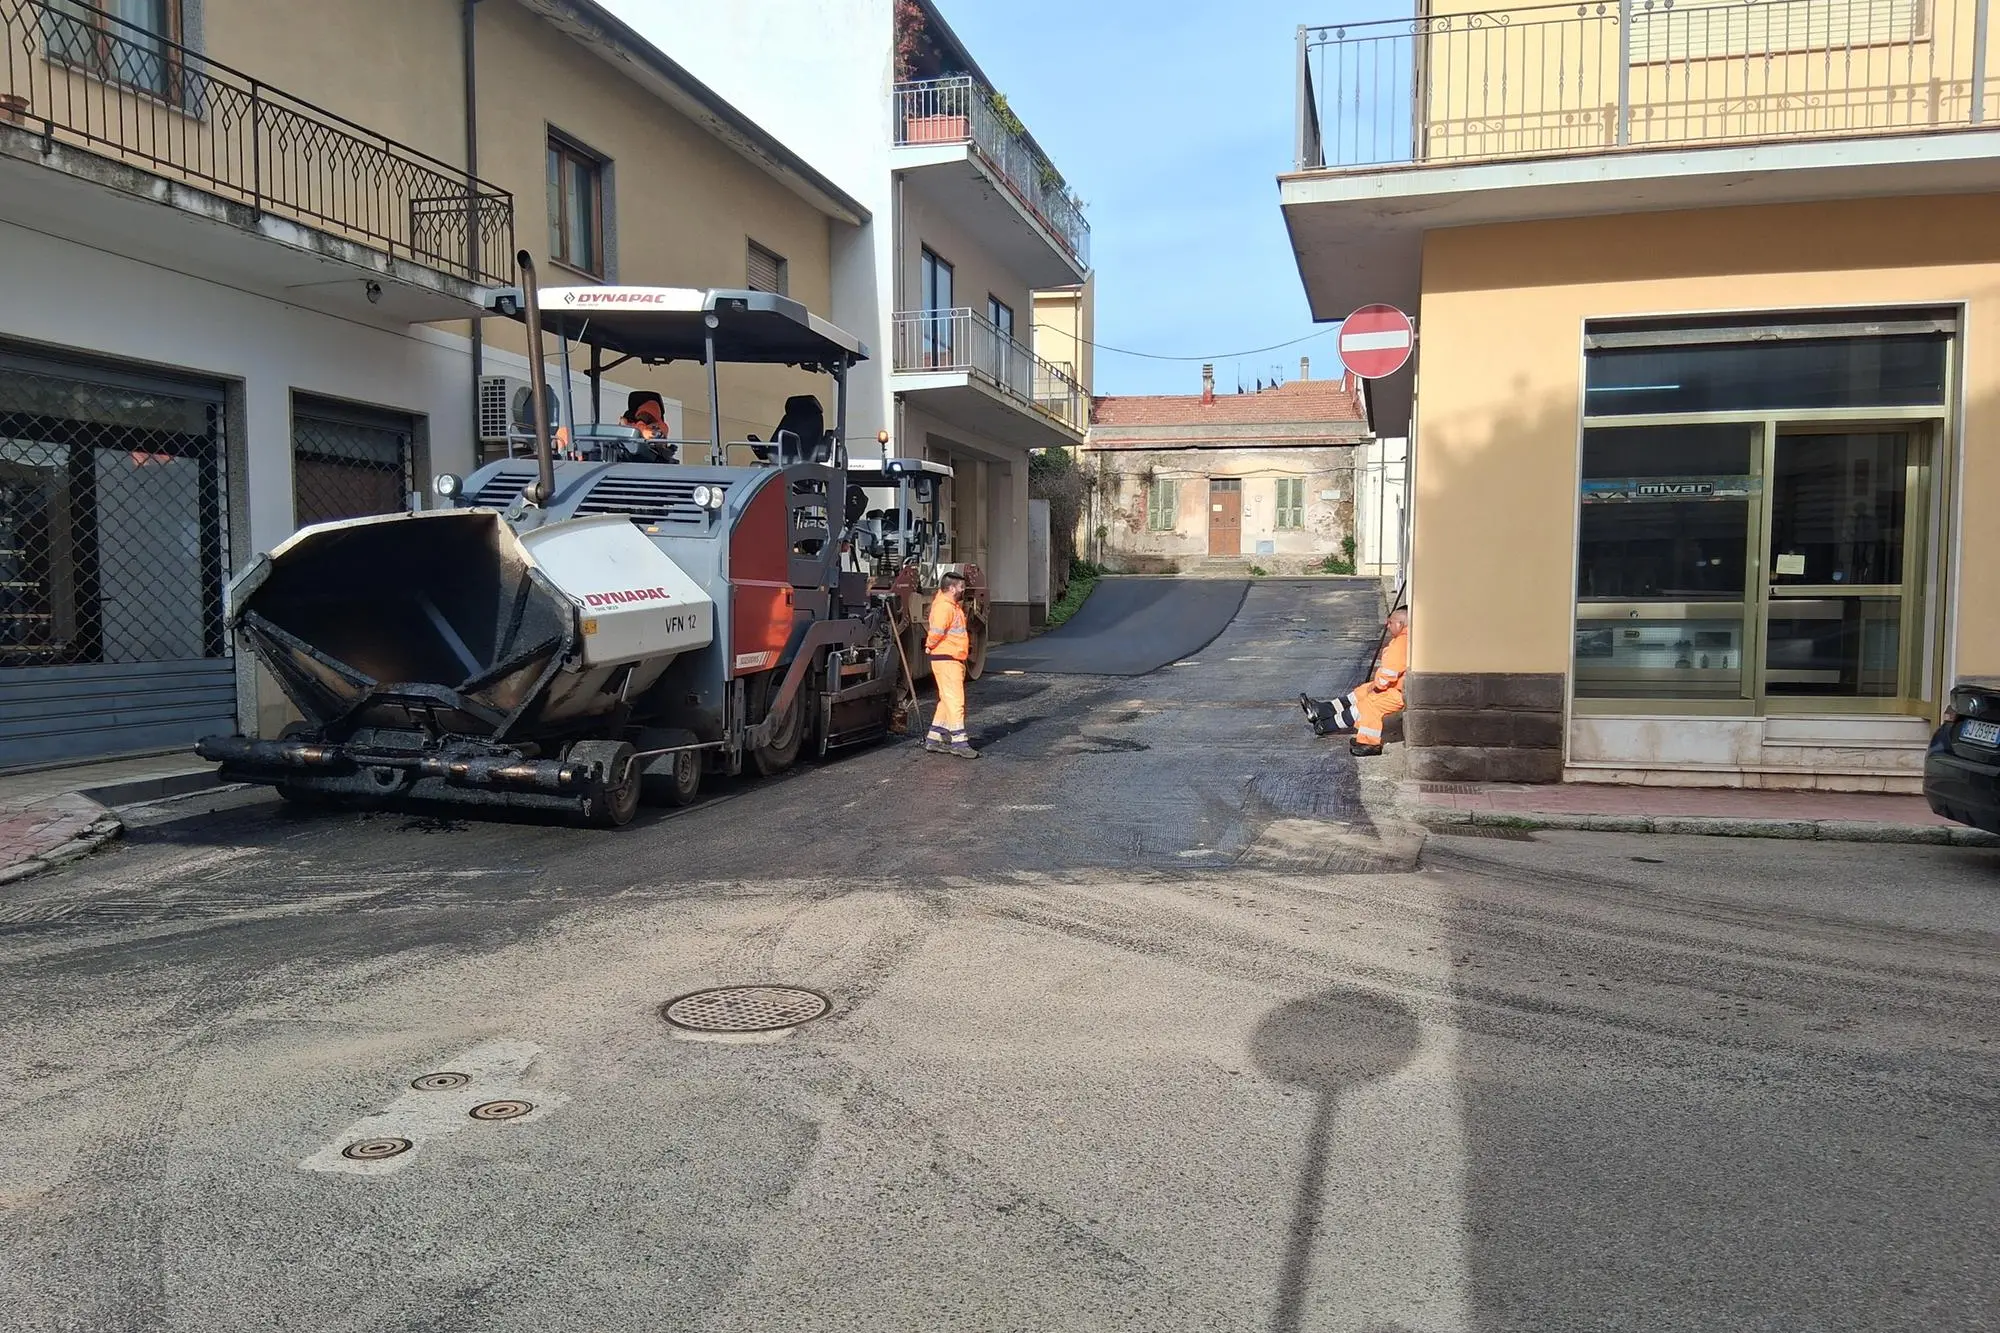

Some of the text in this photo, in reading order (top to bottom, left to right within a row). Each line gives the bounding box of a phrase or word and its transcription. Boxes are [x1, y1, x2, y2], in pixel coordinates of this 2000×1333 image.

[578, 294, 666, 303] DYNAPAC
[1640, 483, 1711, 494] mivar
[585, 587, 671, 606] DYNAPAC
[665, 614, 697, 634] VFN 12
